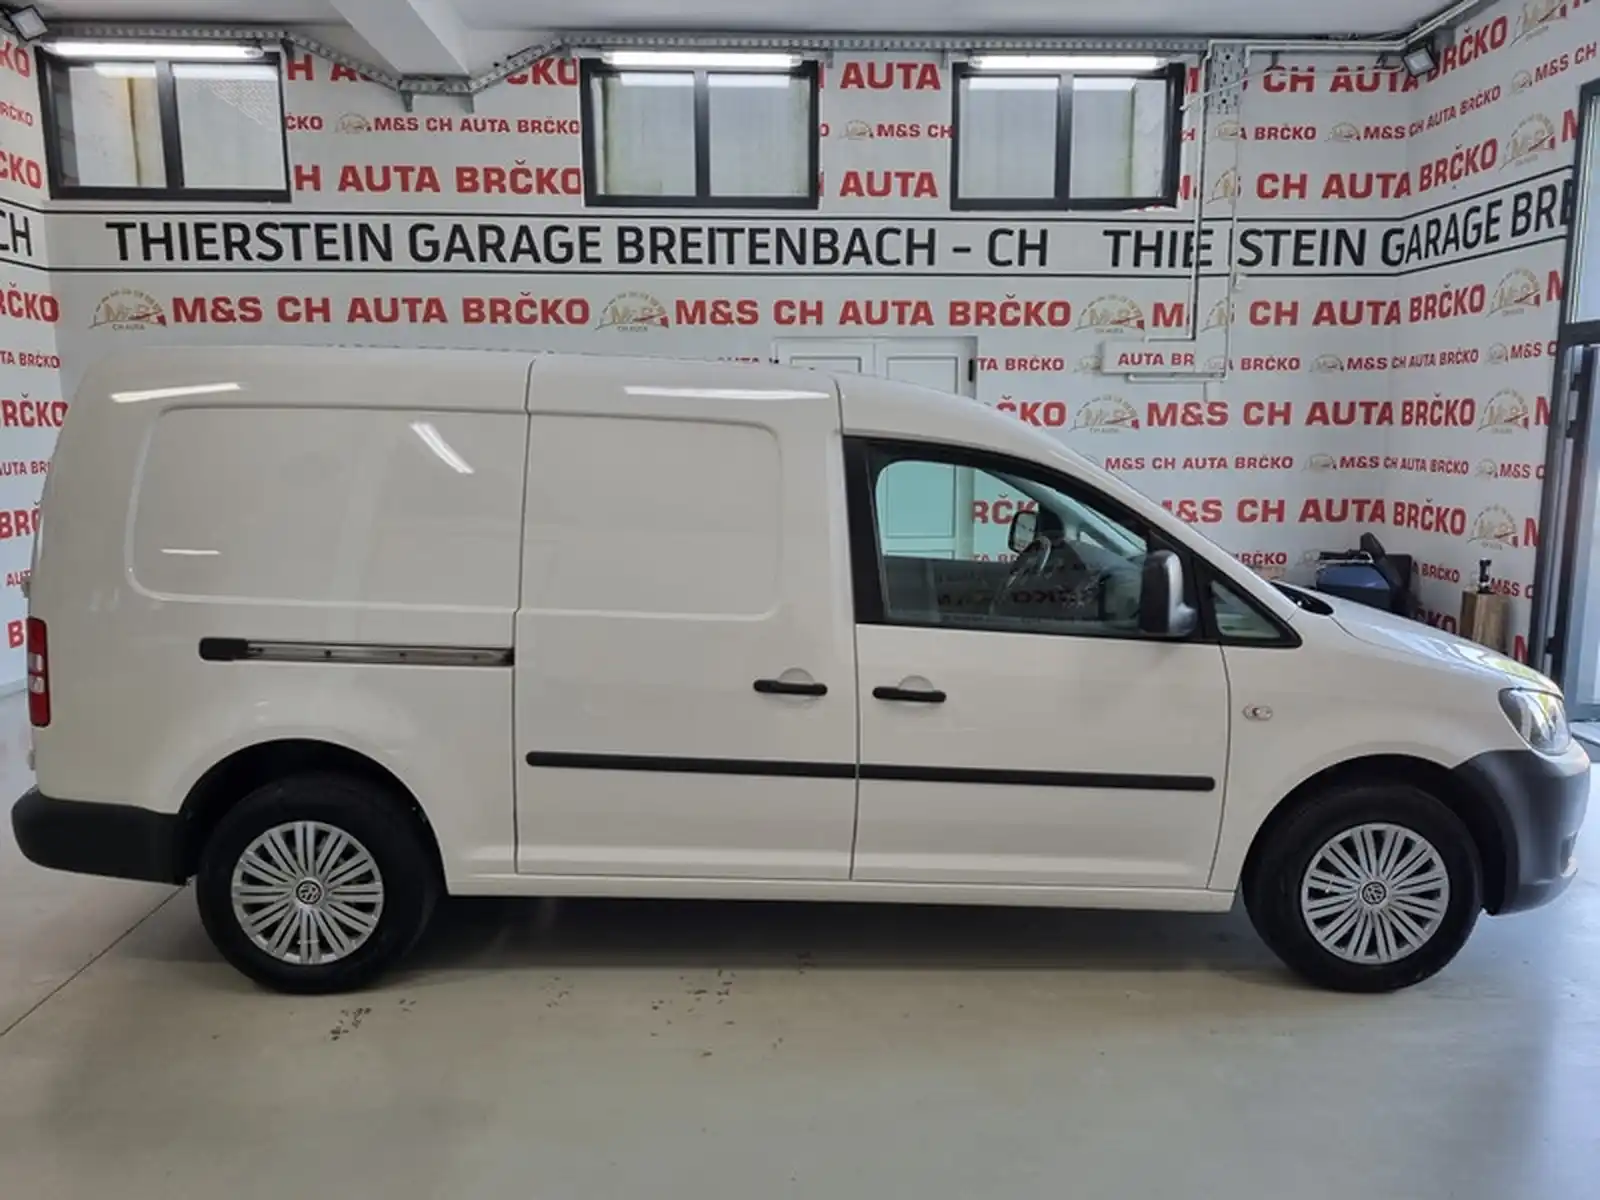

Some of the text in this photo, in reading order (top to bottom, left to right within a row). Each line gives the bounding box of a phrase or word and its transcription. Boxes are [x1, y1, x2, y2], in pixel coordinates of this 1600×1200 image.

[840, 62, 941, 90] AUTA
[1535, 42, 1597, 83] M&S CH
[1263, 66, 1315, 93] CH
[374, 115, 579, 133] M&S CH AUTA BRČKO
[877, 124, 953, 137] M&S CH
[1255, 123, 1316, 140] BRČKO
[1364, 126, 1404, 139] M&S
[1409, 119, 1423, 137] CH
[1426, 106, 1456, 130] AUTA
[338, 160, 582, 195] AUTA BRČKO
[1257, 173, 1307, 199] CH
[1322, 172, 1411, 199] AUTA
[1419, 138, 1498, 192] BRČKO
[840, 172, 938, 198] AUTA
[105, 222, 392, 262] THIERSTEIN
[408, 223, 602, 263] GARAGE
[617, 226, 936, 266] BREITENBACH
[988, 228, 1048, 267] CH
[1381, 199, 1503, 266] GARAGE
[172, 297, 263, 323] M&S
[277, 297, 331, 323] CH
[347, 297, 447, 323] AUTA
[462, 291, 590, 325] BRČKO
[676, 299, 758, 325] M&S
[774, 300, 823, 325] CH
[839, 300, 934, 326] AUTA
[949, 294, 1071, 326] BRČKO
[1250, 301, 1299, 326] CH
[1312, 301, 1400, 326] AUTA
[1409, 283, 1485, 323] BRČKO
[1005, 354, 1064, 371] BRČKO
[1118, 353, 1164, 366] AUTA
[1241, 355, 1300, 371] BRČKO
[1347, 357, 1387, 370] M&S
[1392, 356, 1405, 370] CH
[1408, 353, 1436, 368] AUTA
[1511, 341, 1542, 359] M&S
[1147, 402, 1228, 427] M&S
[1243, 402, 1291, 427] CH
[1305, 402, 1394, 427] AUTA
[1401, 392, 1475, 427] BRČKO
[1105, 454, 1293, 471] M&S CH AUTA BRČKO
[1340, 456, 1379, 469] M&S
[1384, 457, 1397, 470] CH
[1400, 458, 1426, 472] AUTA
[1500, 464, 1529, 479] M&S
[1237, 499, 1284, 523] CH
[1298, 499, 1385, 523] AUTA
[1393, 498, 1466, 536] BRČKO
